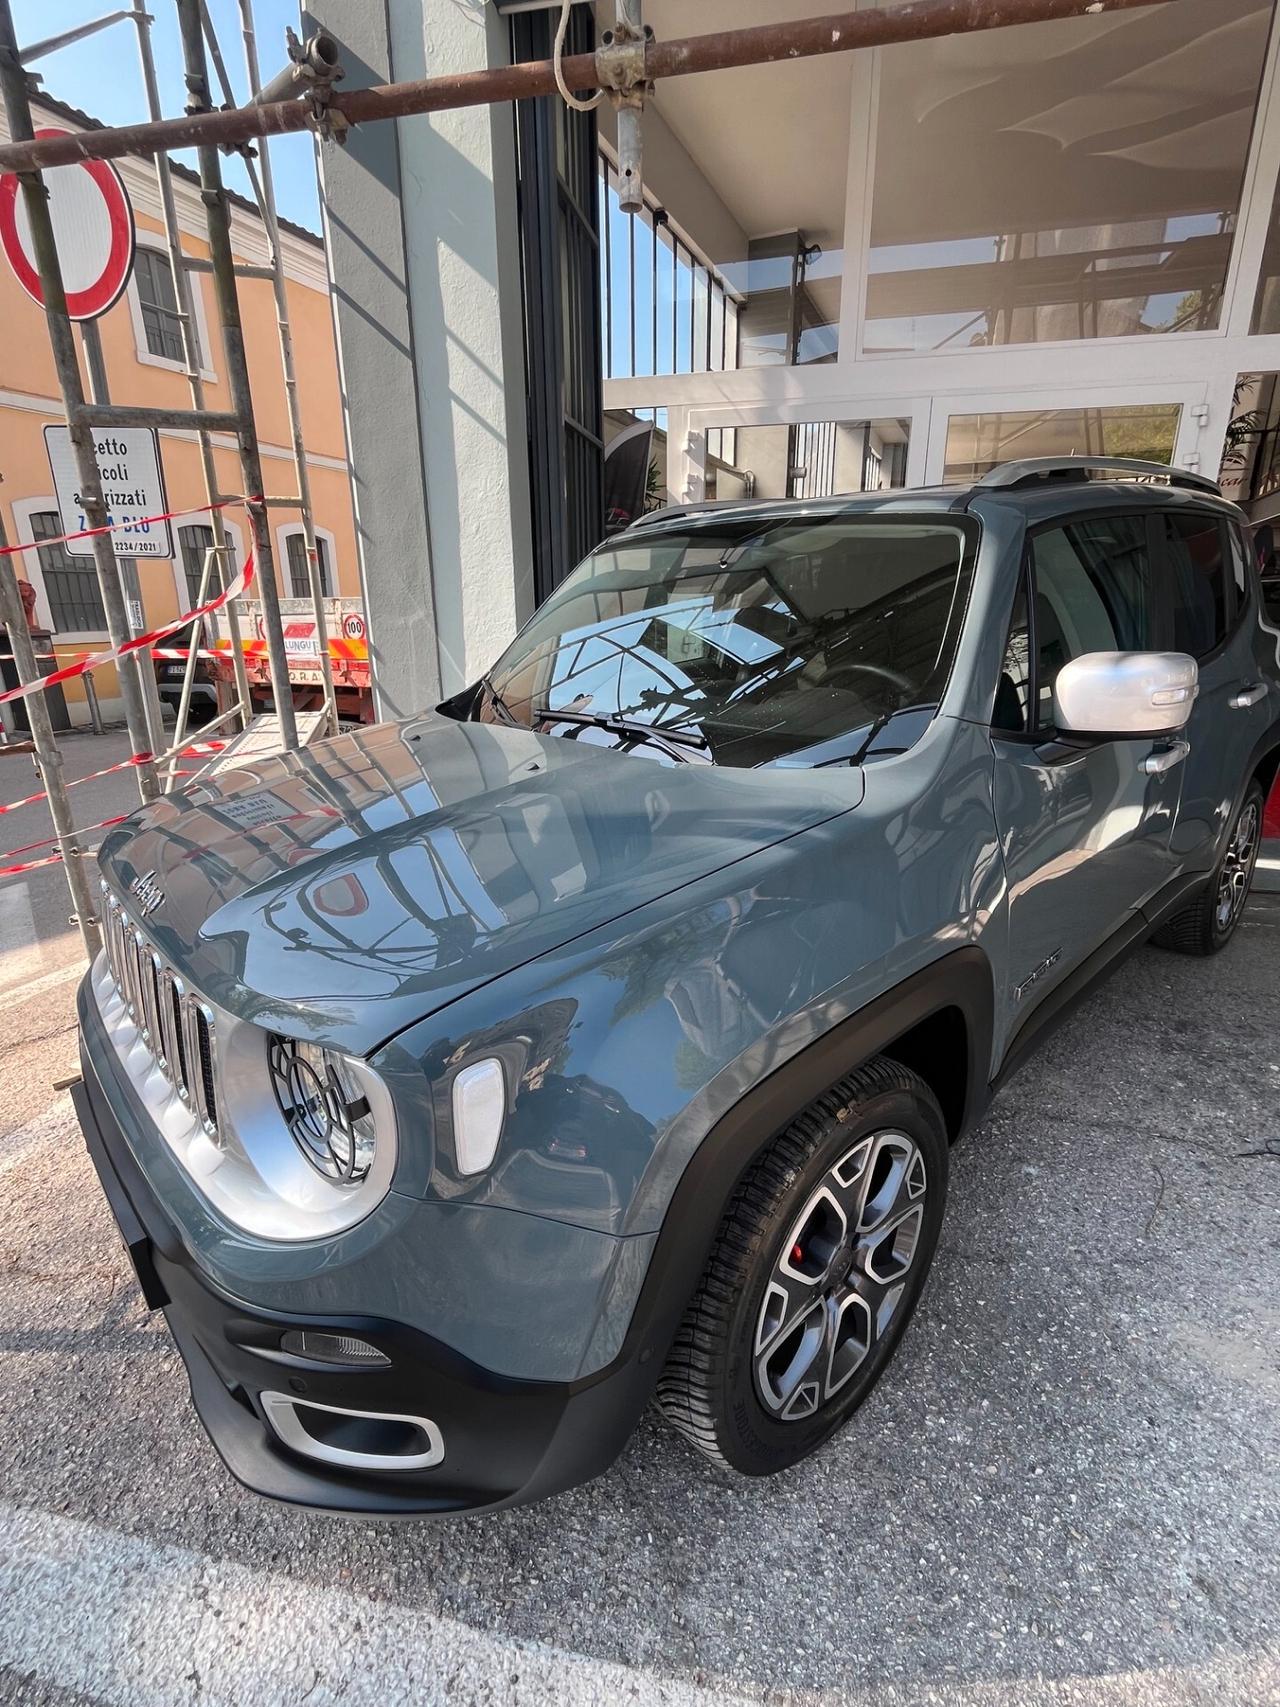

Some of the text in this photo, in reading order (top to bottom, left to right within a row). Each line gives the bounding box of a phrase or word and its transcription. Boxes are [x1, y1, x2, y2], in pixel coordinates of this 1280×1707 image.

[94, 437, 128, 456] etto
[97, 463, 129, 481] icoli
[73, 488, 147, 506] arizzati
[78, 514, 150, 534] ZA BLU
[114, 541, 156, 552] 2234/2021
[347, 621, 362, 634] 100
[128, 870, 167, 917] Jeep
